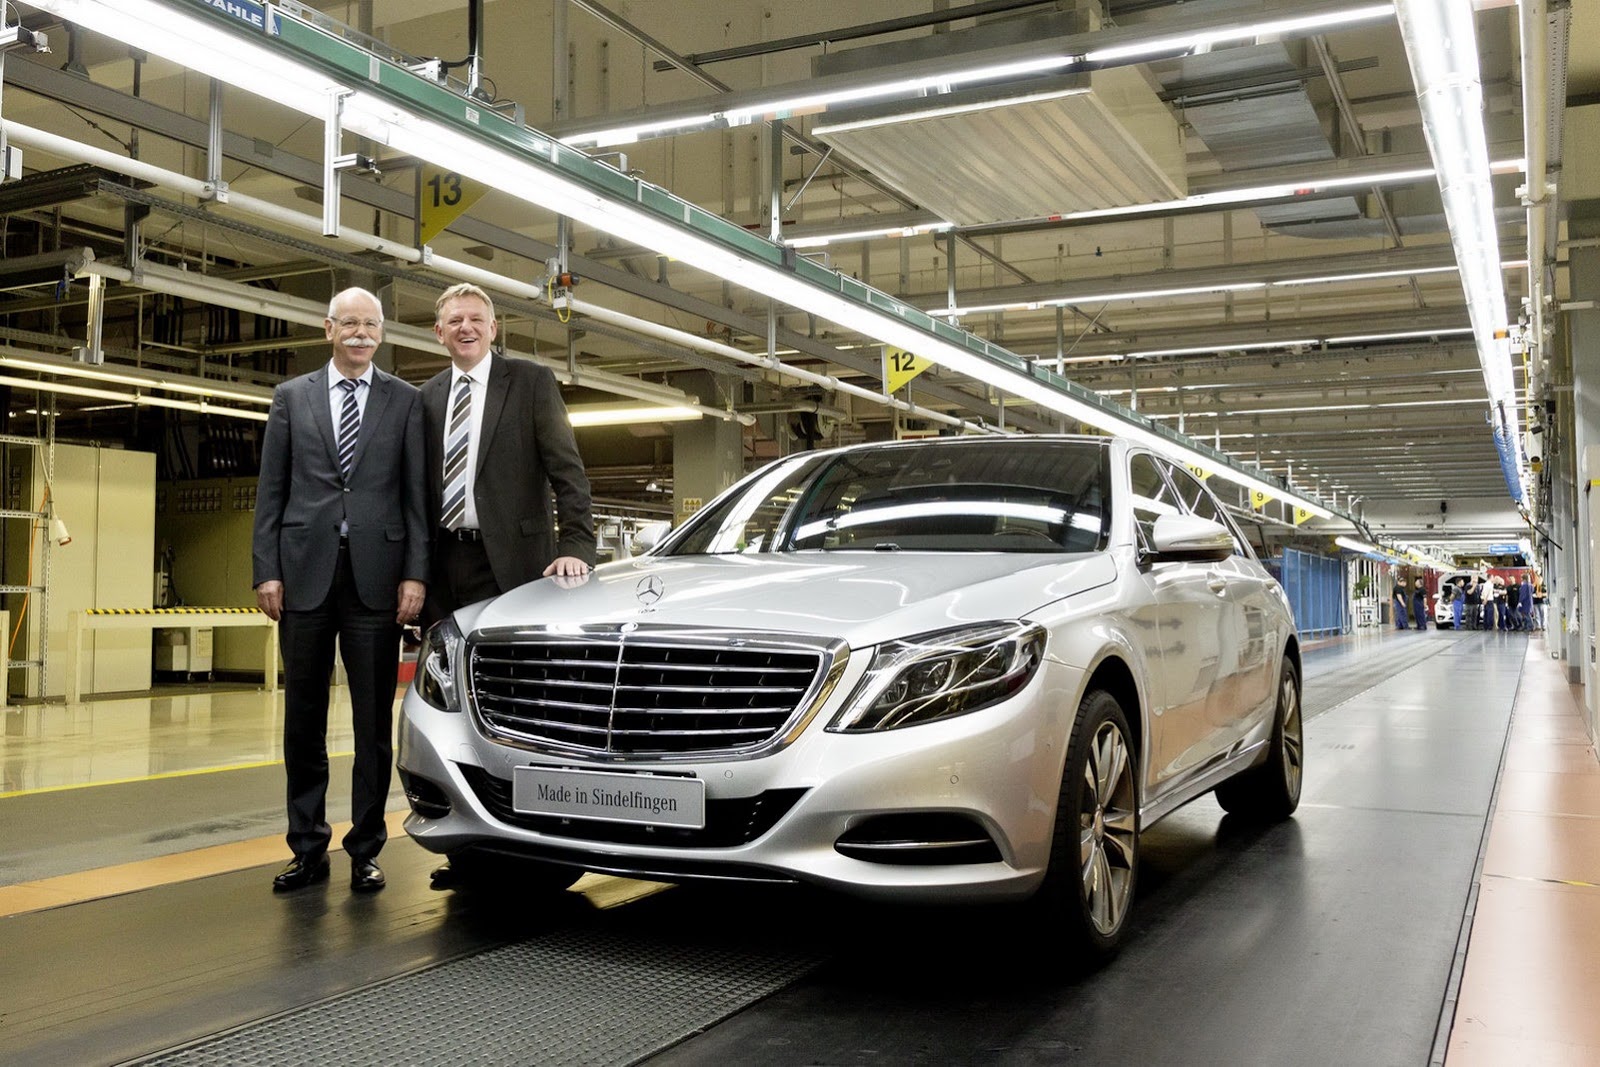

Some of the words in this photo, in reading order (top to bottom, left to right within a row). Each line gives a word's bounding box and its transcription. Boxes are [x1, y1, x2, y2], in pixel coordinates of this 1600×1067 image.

[427, 170, 462, 208] 13
[890, 351, 916, 372] 12
[1256, 492, 1264, 501] 9
[1299, 509, 1306, 518] 8
[537, 783, 571, 803] Made
[575, 787, 588, 804] in
[592, 788, 678, 814] Sindelfingen
